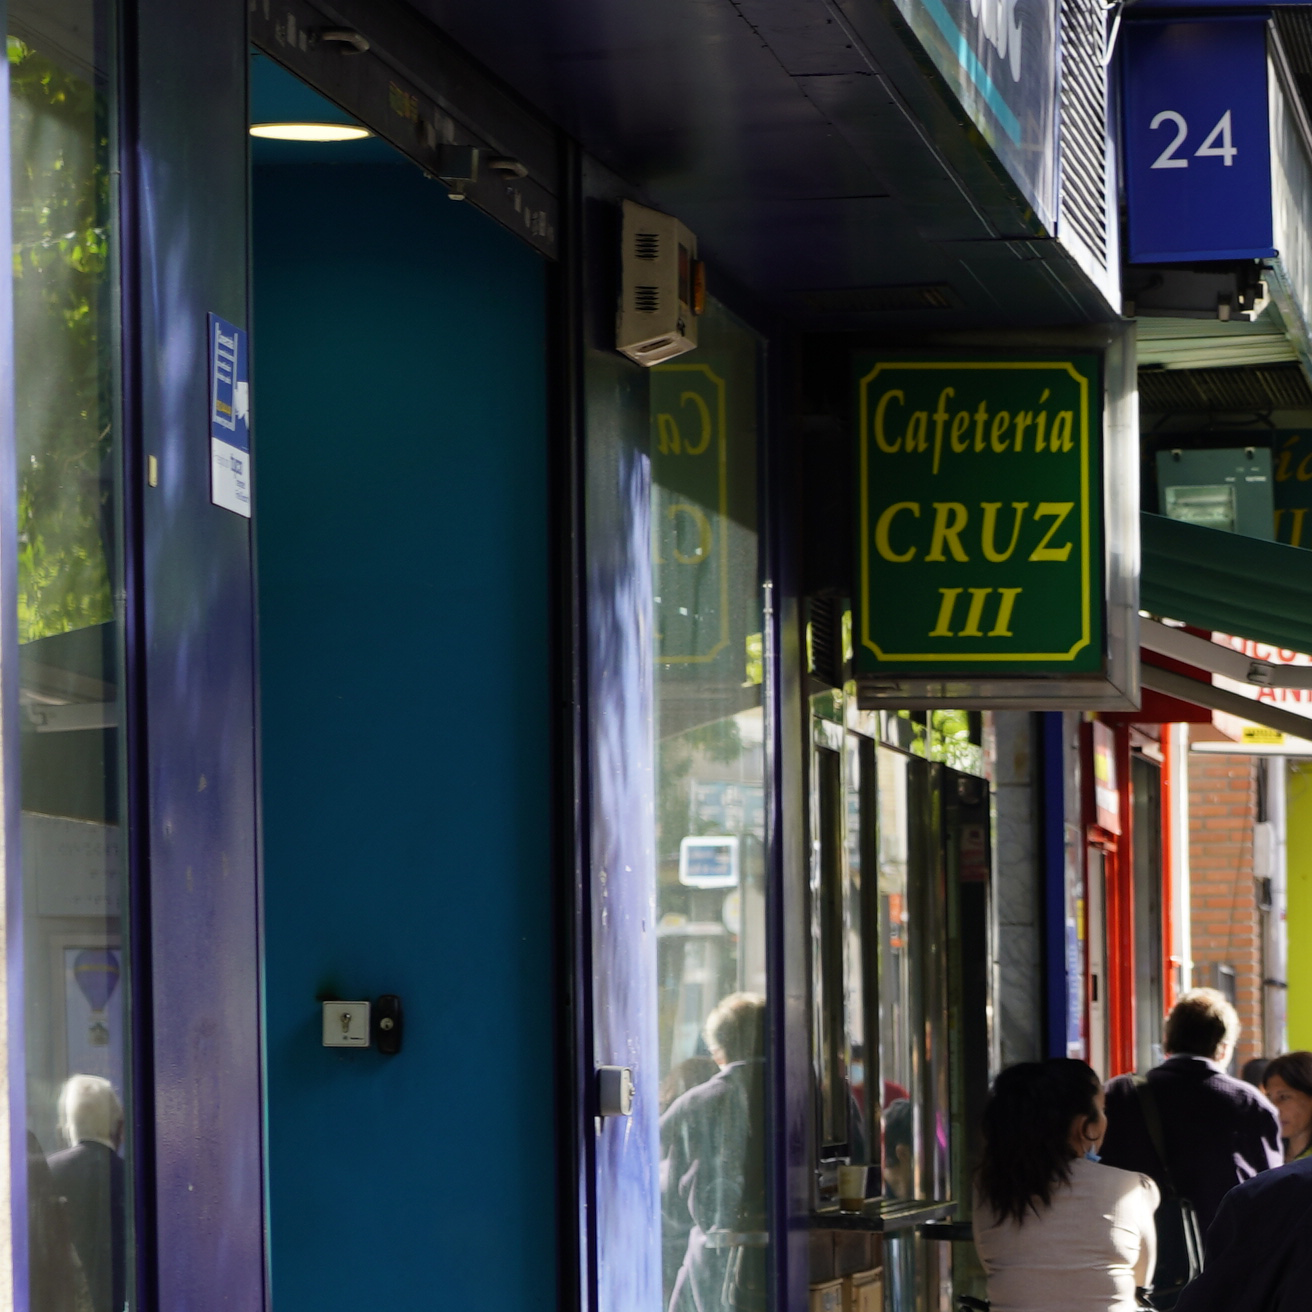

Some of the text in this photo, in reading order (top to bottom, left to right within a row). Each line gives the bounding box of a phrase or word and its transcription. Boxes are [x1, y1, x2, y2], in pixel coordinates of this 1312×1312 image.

[1149, 109, 1238, 169] 24
[874, 387, 1074, 475] Cafetería
[874, 502, 1075, 562] CRUZ
[928, 588, 1023, 637] III
